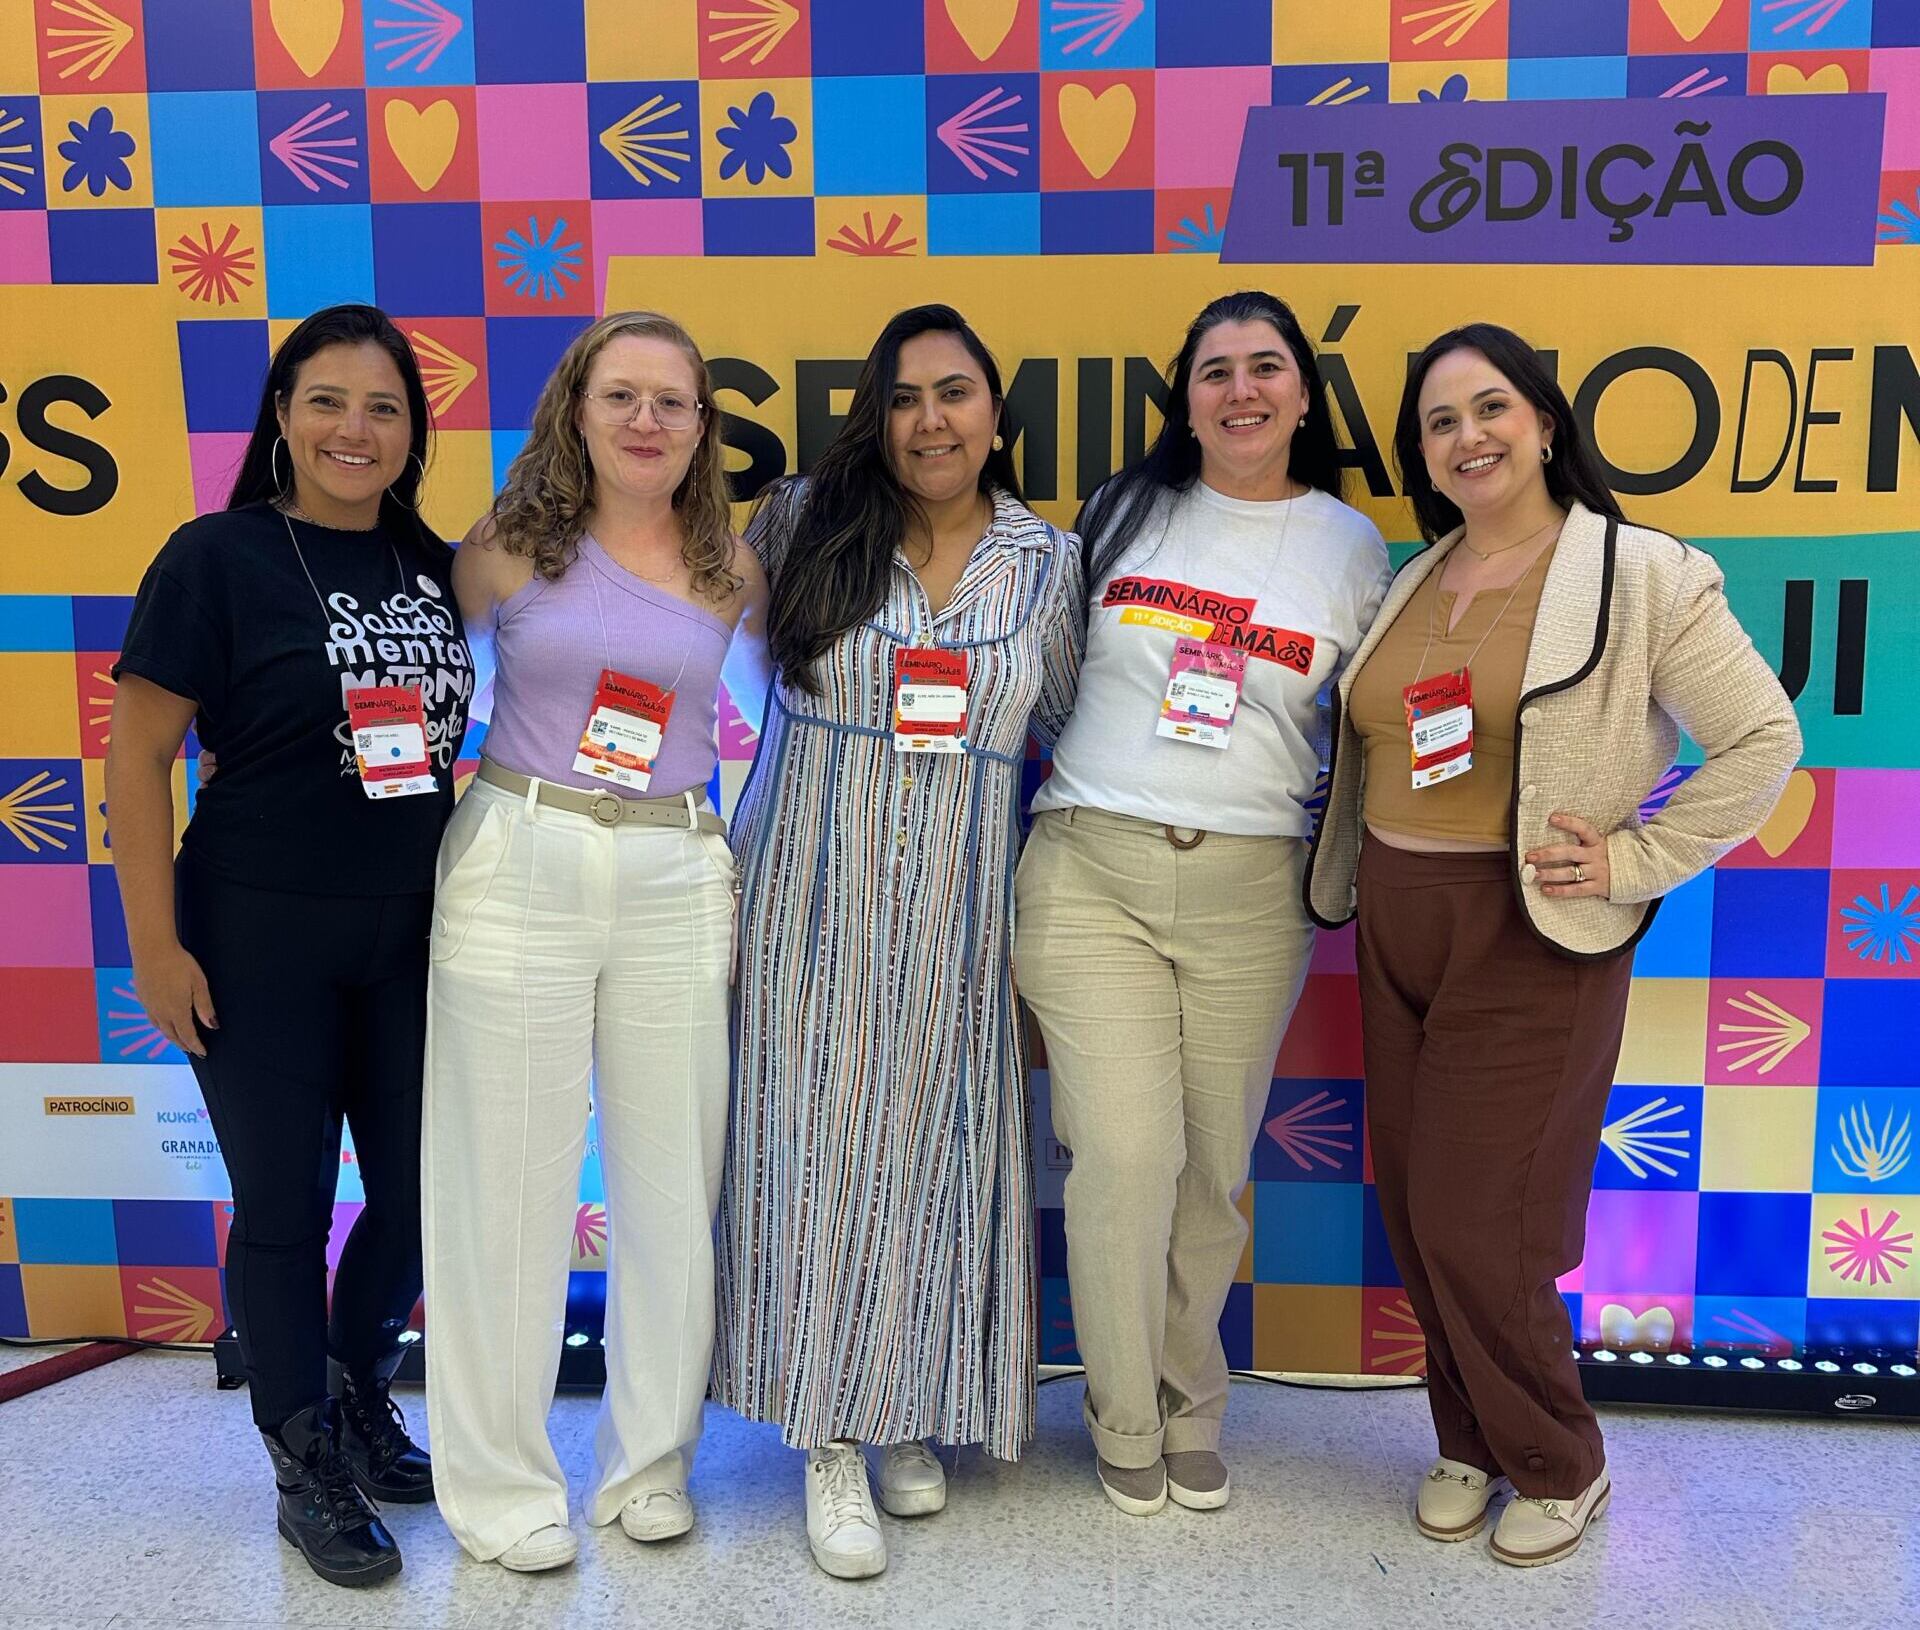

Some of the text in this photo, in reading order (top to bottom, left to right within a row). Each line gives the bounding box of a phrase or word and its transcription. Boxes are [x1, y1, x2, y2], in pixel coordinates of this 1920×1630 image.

[1278, 120, 1804, 243] 11ª EDIÇÃO
[1730, 348, 1854, 494] DE
[328, 592, 455, 642] Saúde
[1103, 581, 1248, 624] SEMINÁRIO
[1149, 614, 1194, 632] EDIÇÃO
[325, 635, 474, 669] mental
[1211, 621, 1312, 669] DE MÃES
[354, 699, 396, 710] SEMINÁRIO
[49, 1099, 129, 1113] PATROCÍNIO
[157, 1111, 198, 1123] KUKA
